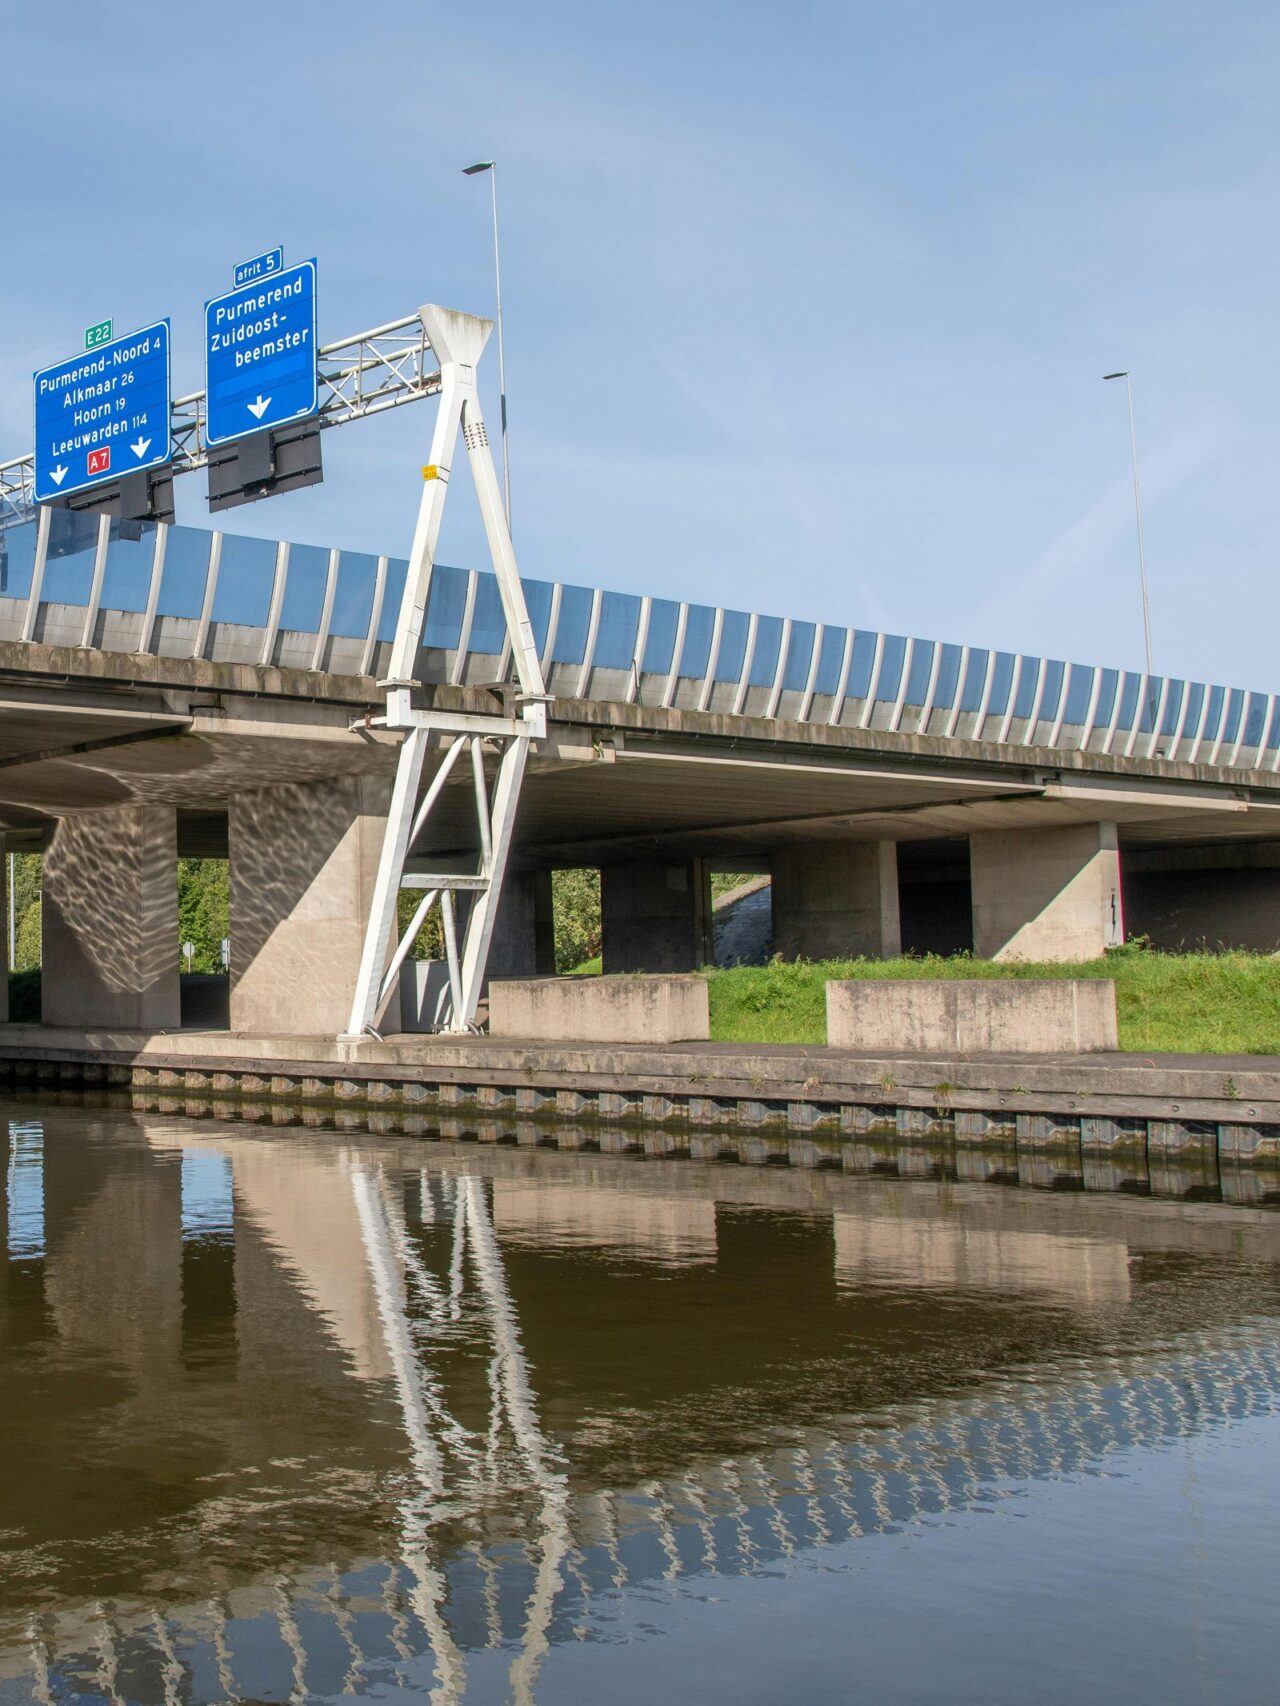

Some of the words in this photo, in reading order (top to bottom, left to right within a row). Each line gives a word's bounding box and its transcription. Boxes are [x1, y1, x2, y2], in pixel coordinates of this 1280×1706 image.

[237, 262, 261, 281] afrit
[266, 255, 275, 271] 5
[216, 276, 302, 326] Purmerend
[211, 312, 287, 352] Zuidoost-
[235, 328, 309, 368] beemster
[40, 338, 150, 395] Purmerend-Noord
[153, 337, 161, 349] 4
[63, 376, 118, 408] Alkmaar
[121, 371, 135, 386] 26
[73, 402, 111, 427] Hoorn
[115, 397, 126, 411] 19
[52, 420, 128, 457] Leeuwarden
[132, 413, 148, 429] 114
